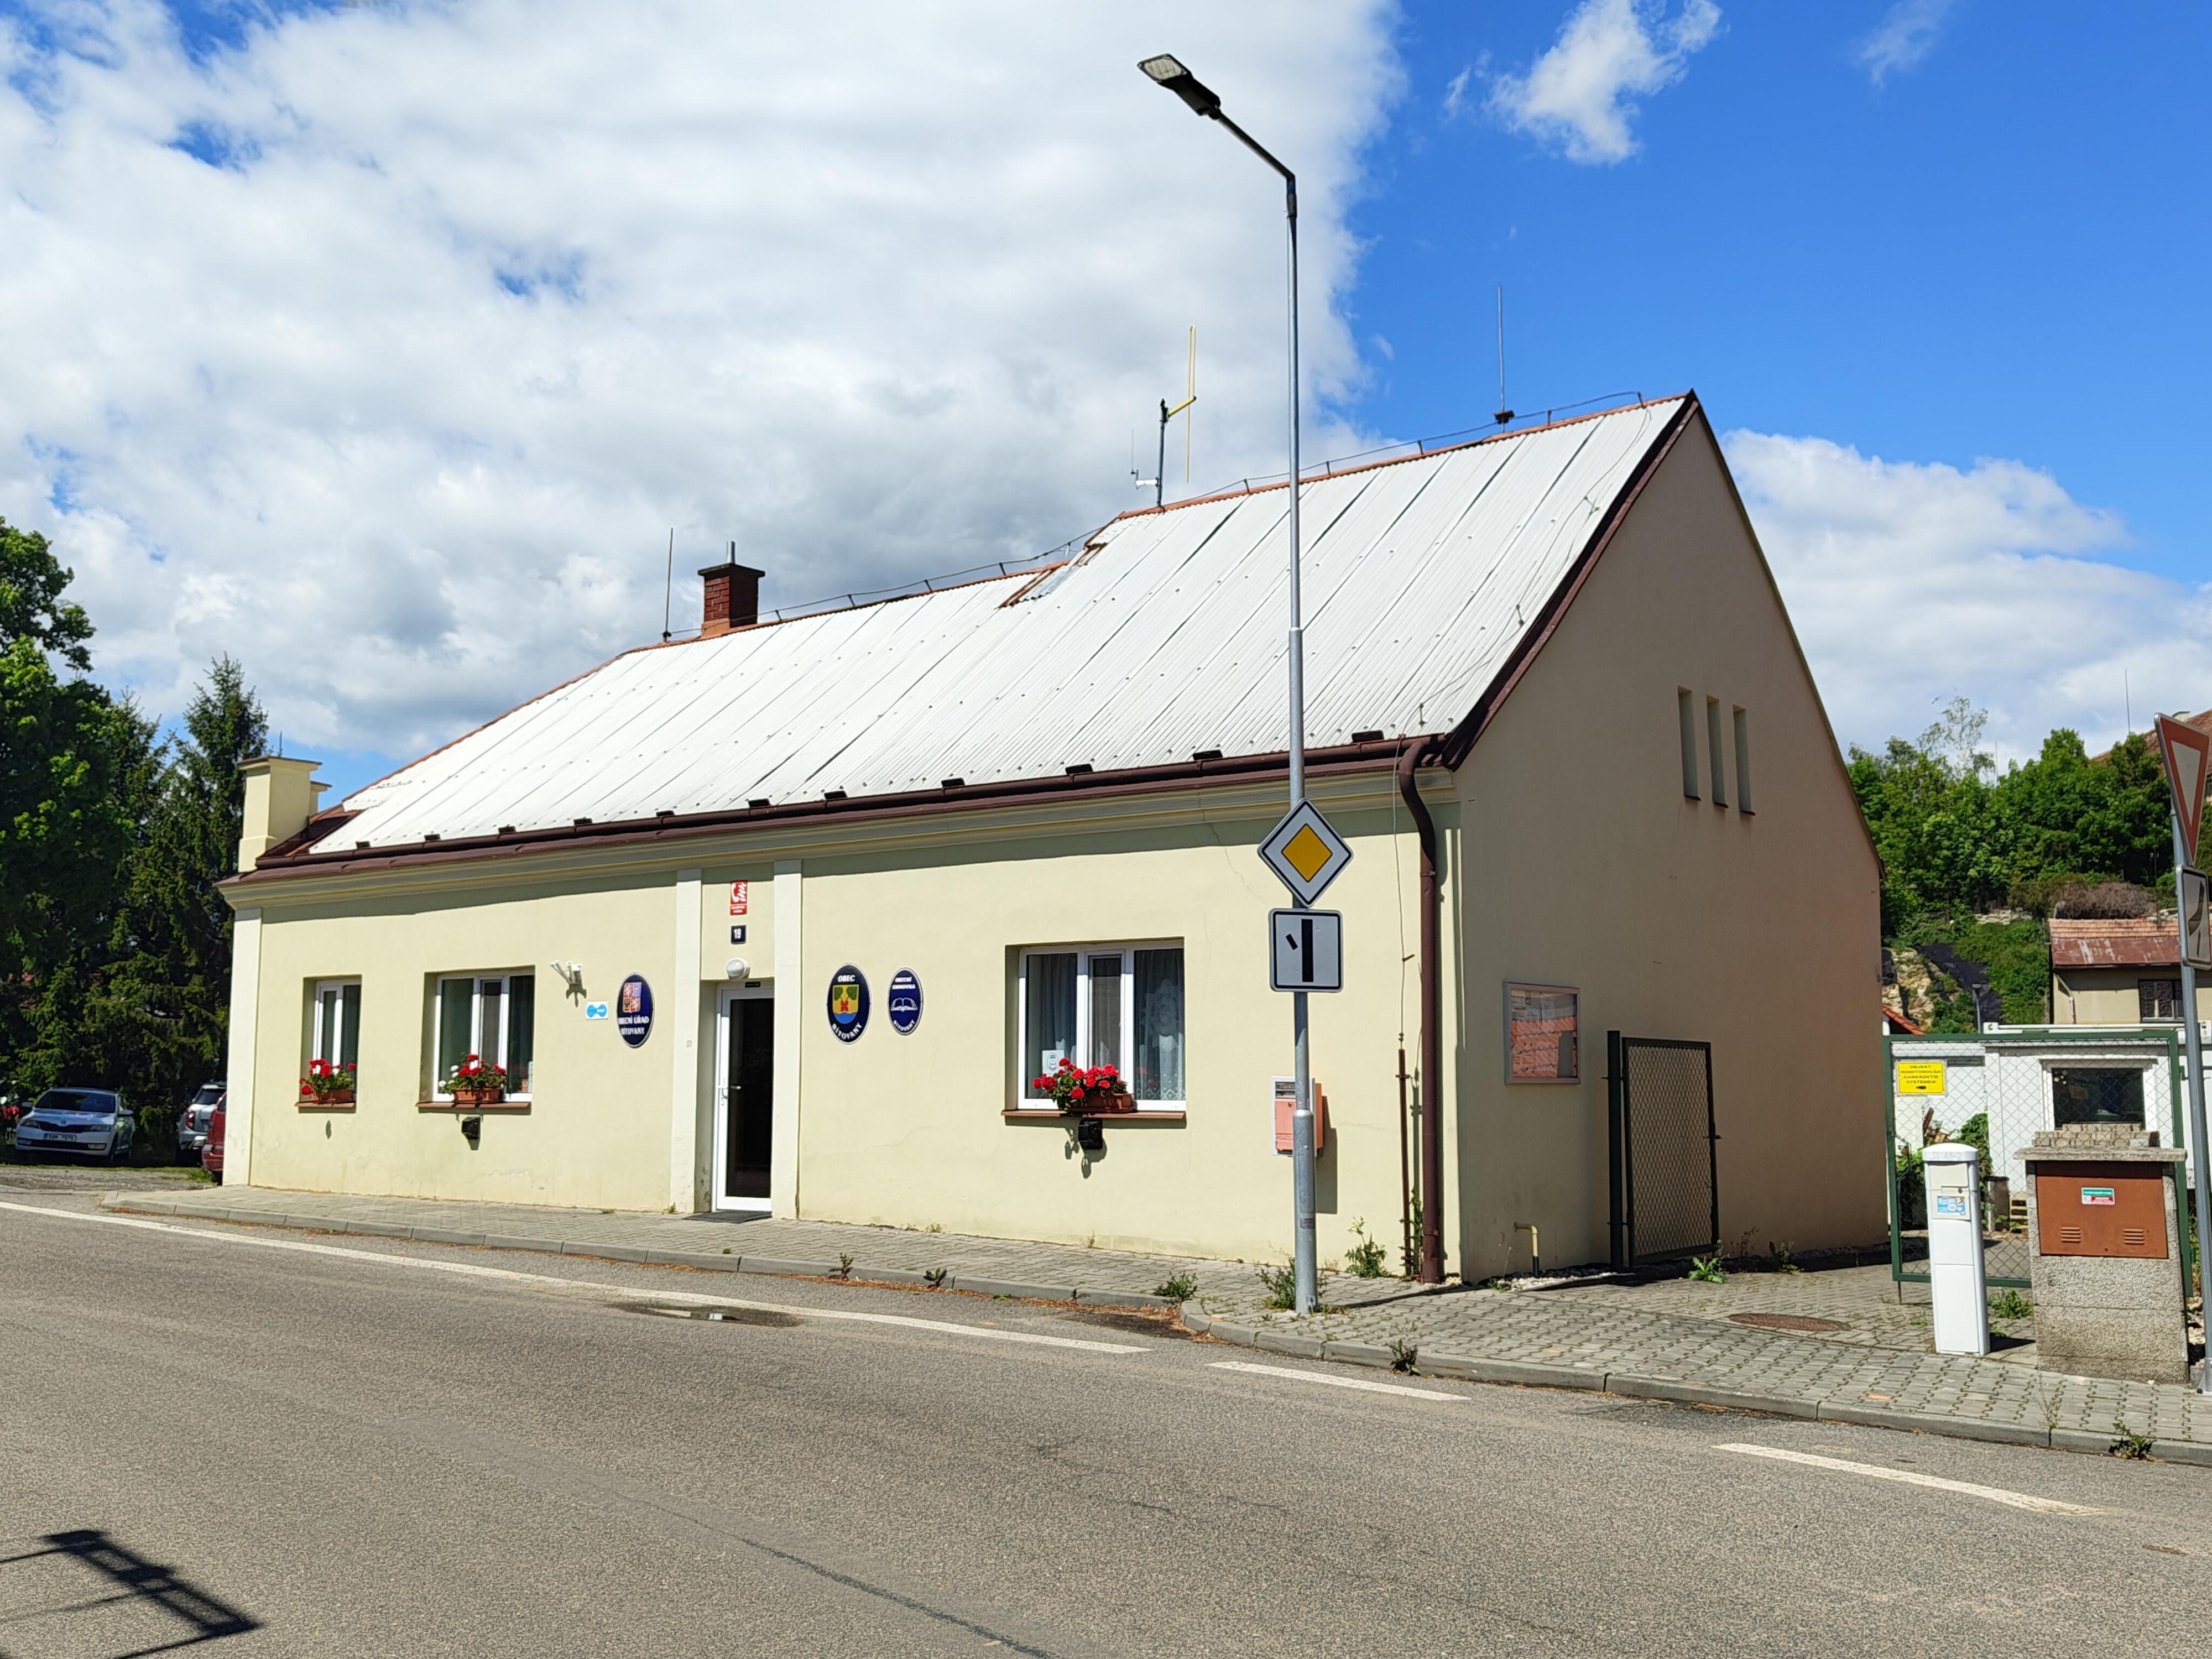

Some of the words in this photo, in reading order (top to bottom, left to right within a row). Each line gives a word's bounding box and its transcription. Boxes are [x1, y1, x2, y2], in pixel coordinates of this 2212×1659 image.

[733, 928, 742, 939] 19
[634, 1014, 649, 1024] ÚŘAD
[831, 1022, 862, 1040] BÍTOVANY
